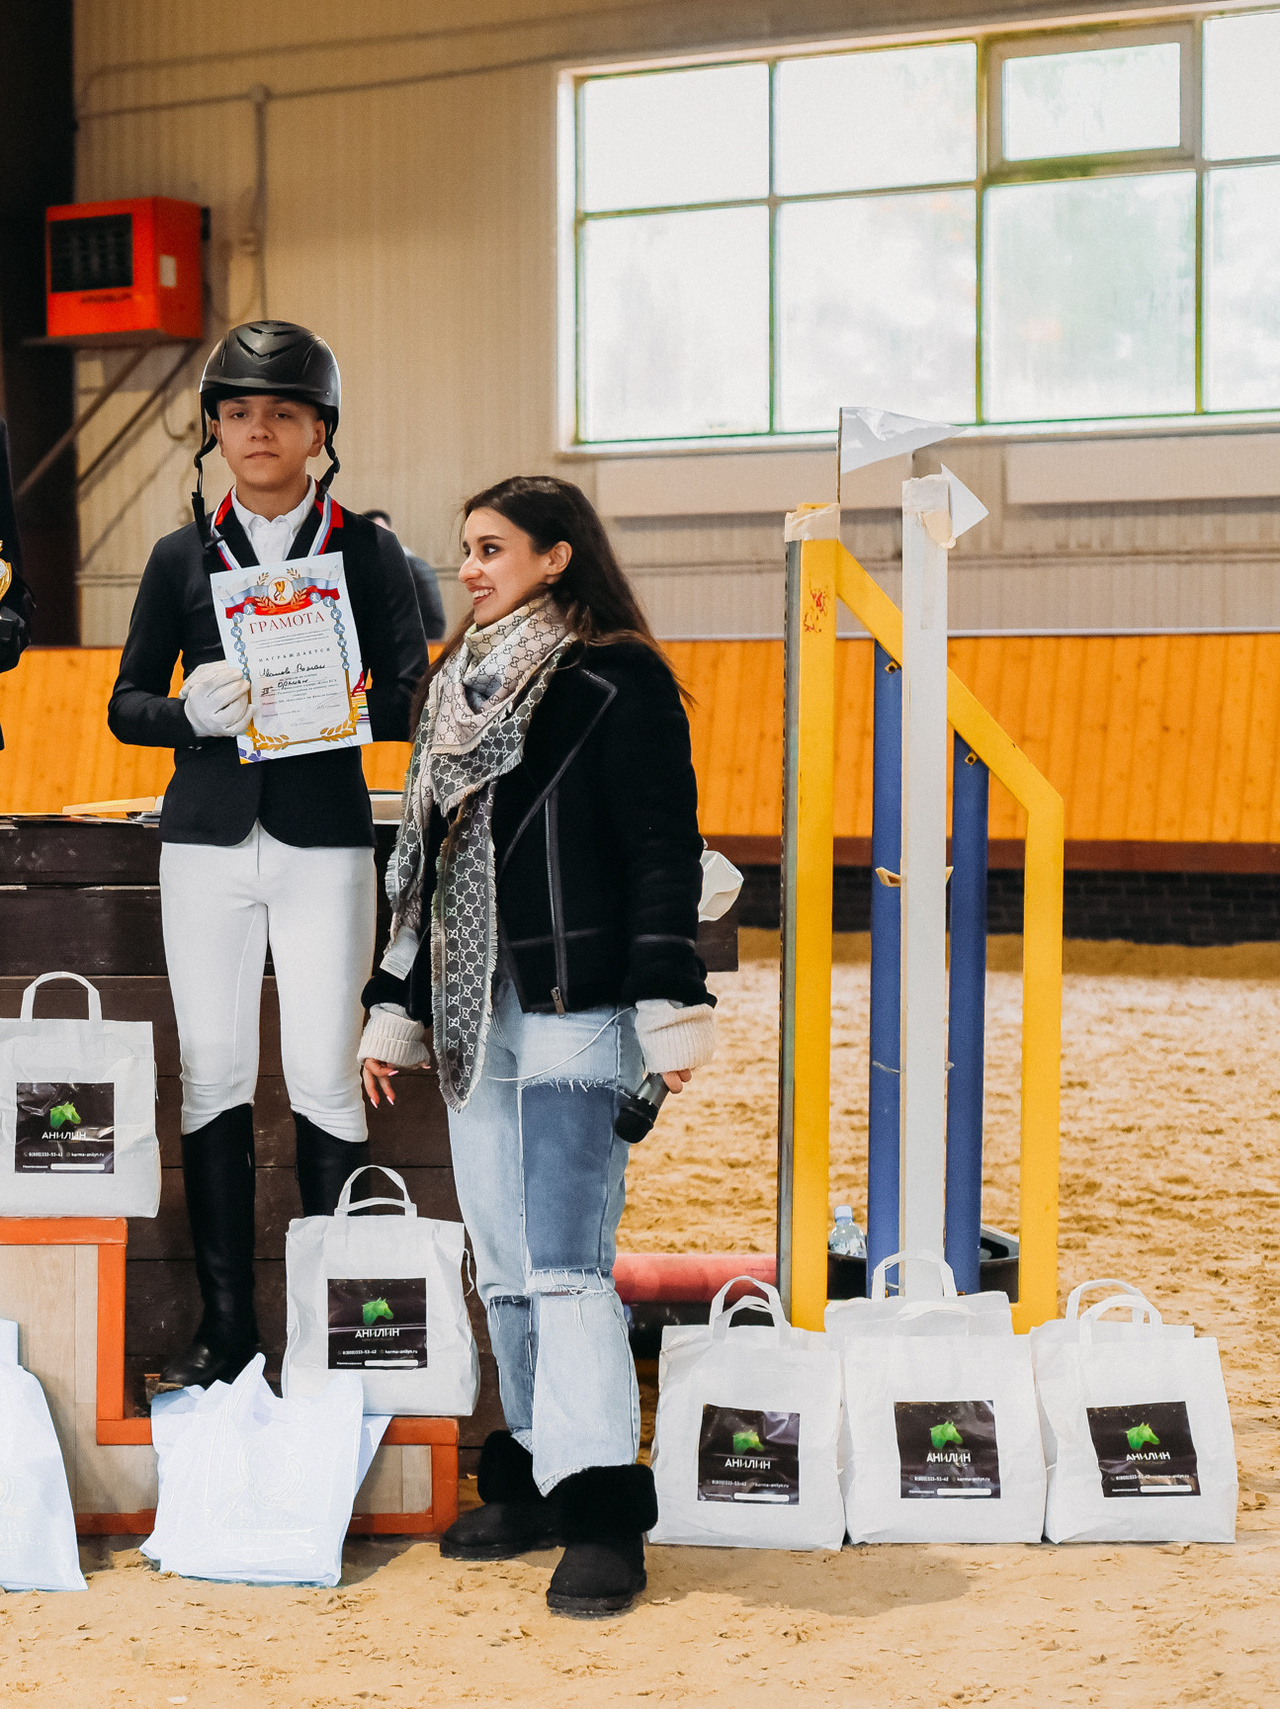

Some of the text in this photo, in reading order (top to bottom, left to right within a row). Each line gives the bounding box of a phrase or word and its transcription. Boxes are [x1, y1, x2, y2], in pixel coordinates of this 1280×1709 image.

[249, 611, 325, 634] ГРАМОТА
[258, 647, 331, 663] НАГРАЖДАЕТСЯ
[41, 1131, 87, 1140] АНИЛИН
[355, 1328, 400, 1339] АНИЛИН
[926, 1452, 971, 1463] АНИЛИН
[1126, 1451, 1171, 1462] АНИЛИН
[724, 1458, 771, 1470] АНИЛИН
